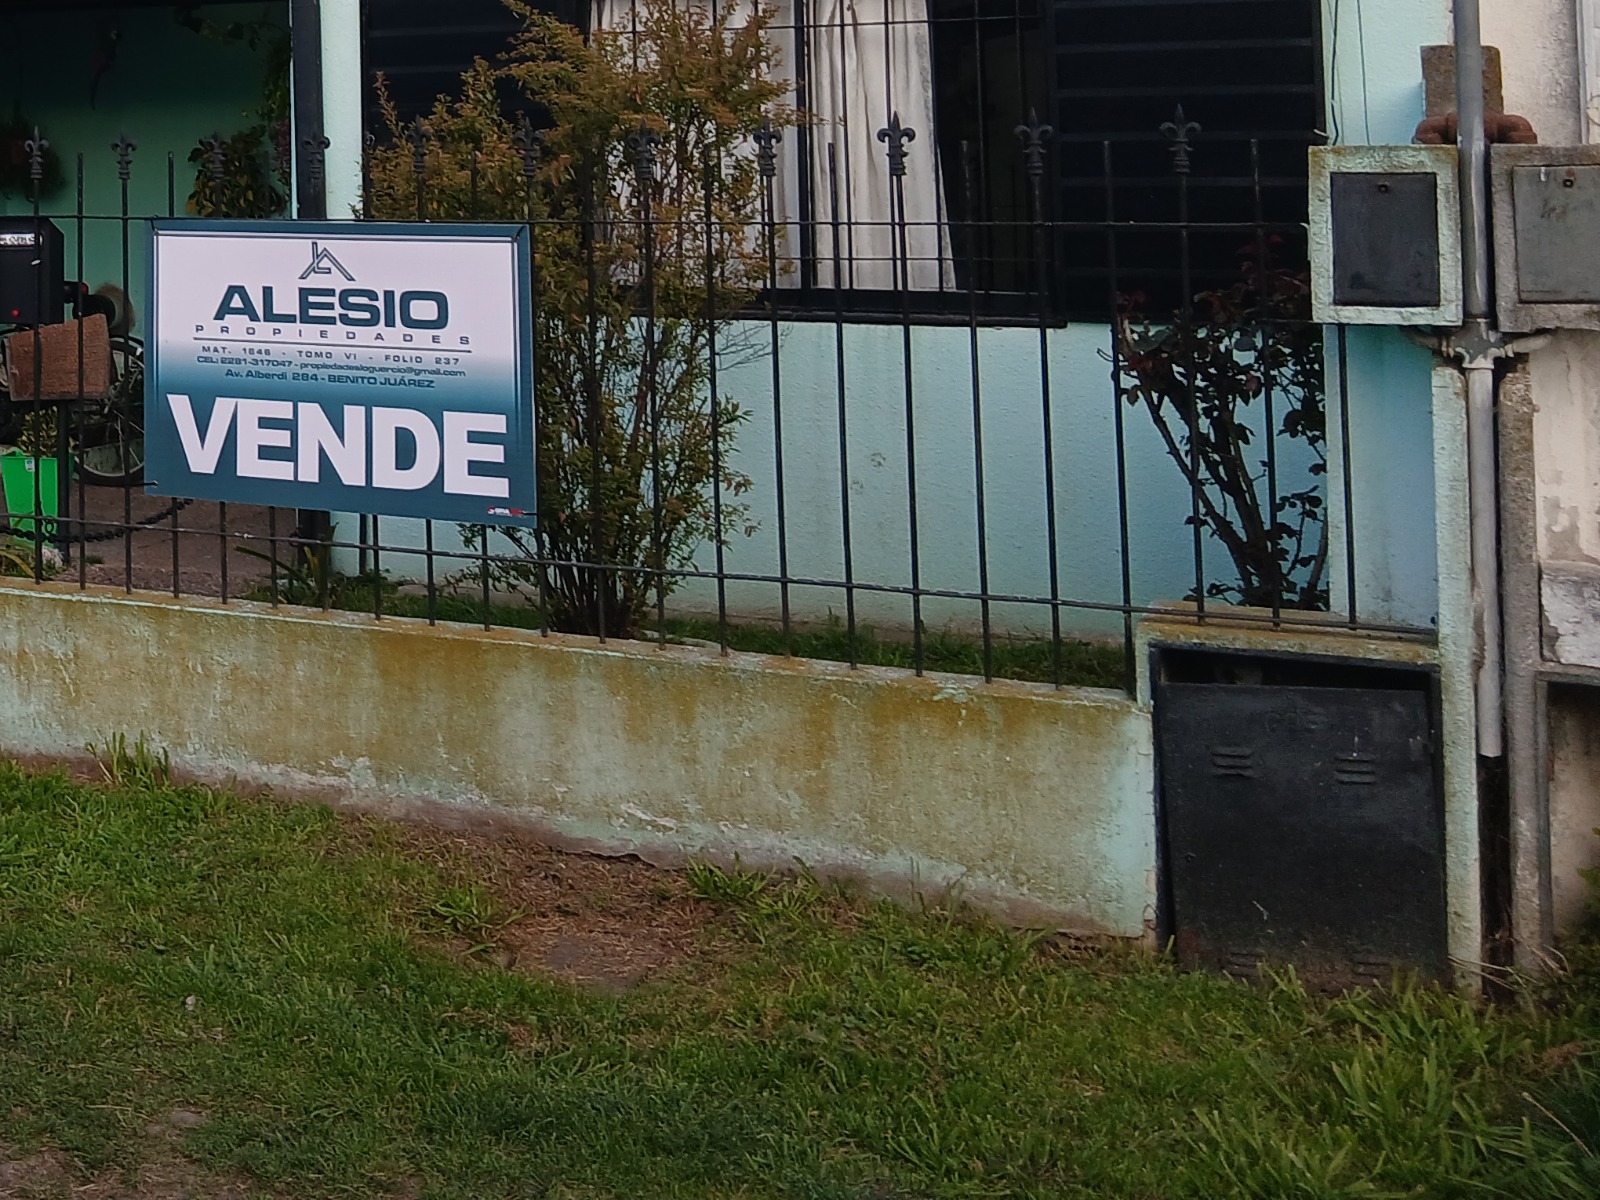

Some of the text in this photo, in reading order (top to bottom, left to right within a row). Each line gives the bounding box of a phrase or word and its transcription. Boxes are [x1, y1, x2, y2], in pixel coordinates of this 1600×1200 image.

[213, 284, 449, 330] ALESIO
[195, 324, 471, 345] PROPIEDADES
[202, 345, 232, 355] MAT.
[297, 350, 333, 359] TOMO
[384, 354, 423, 363] FOLIO
[434, 357, 460, 365] 237
[225, 369, 243, 378] Av.
[245, 370, 288, 381] Alberdi
[291, 372, 319, 382] 284
[327, 374, 378, 385] BENITO
[379, 374, 436, 389] JUÁREZ
[166, 393, 511, 499] VENDE
